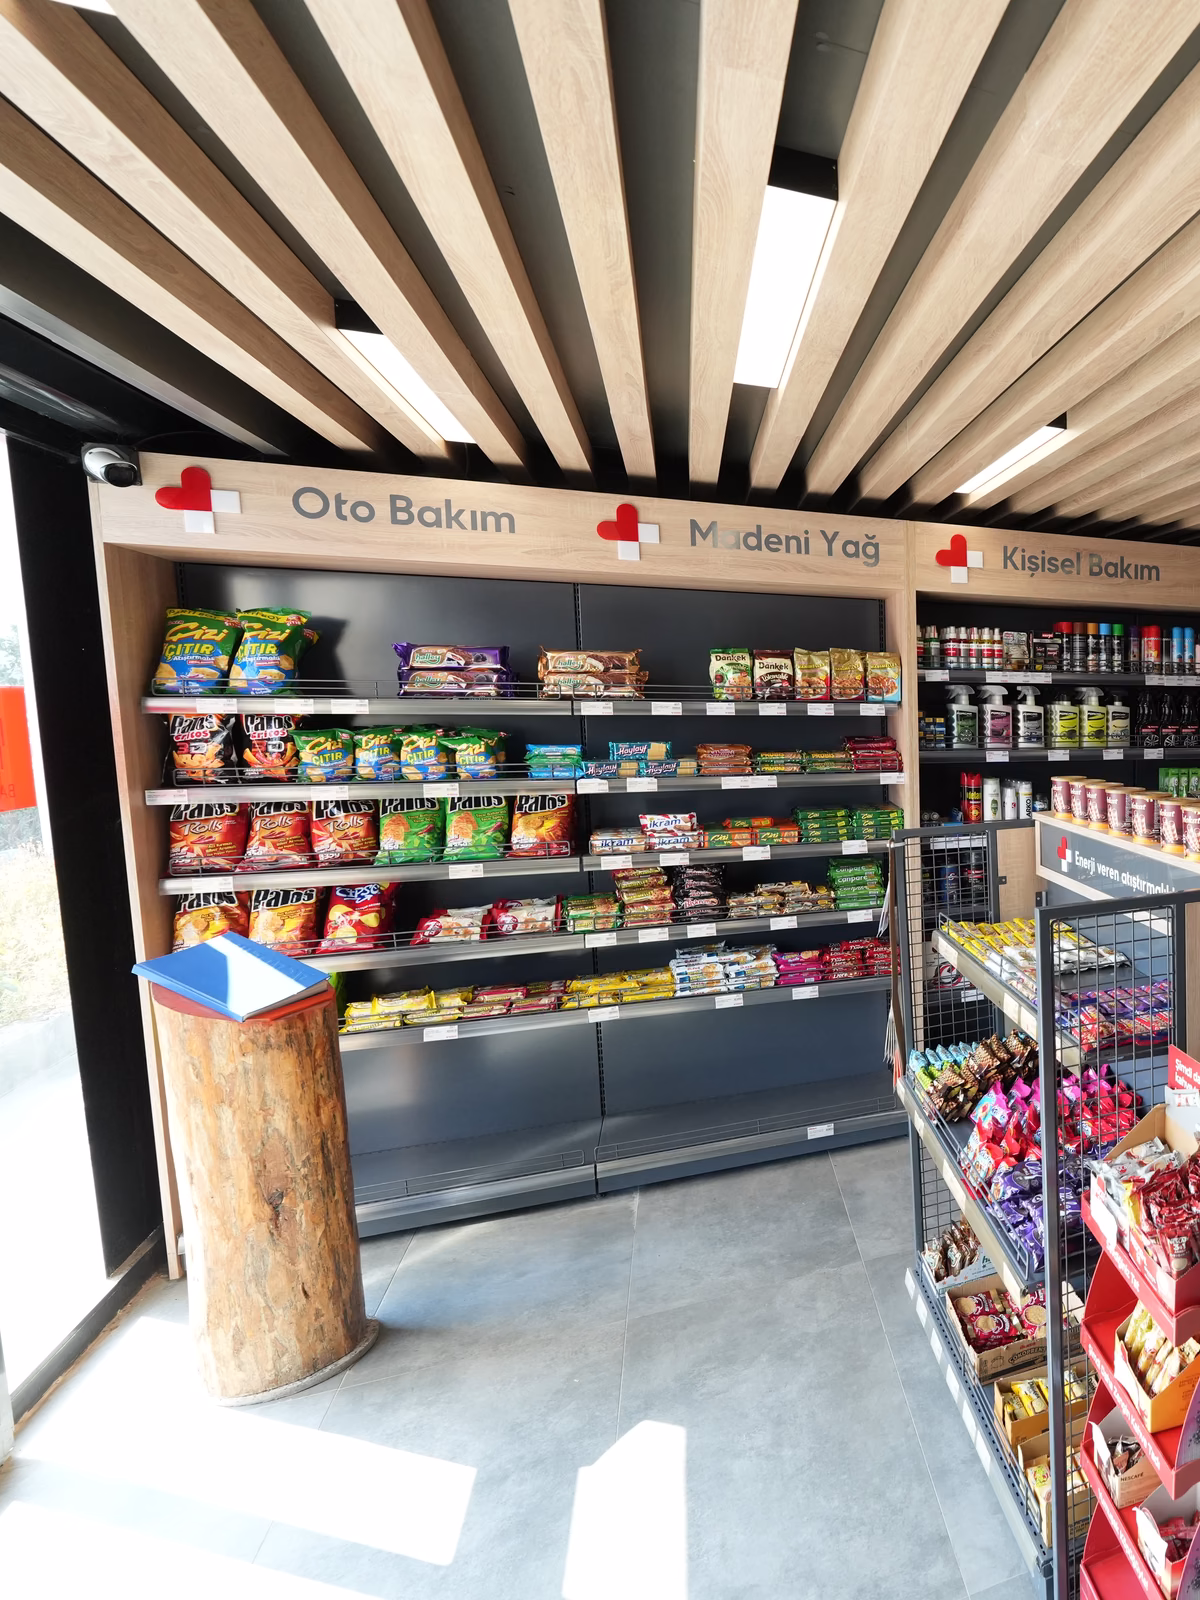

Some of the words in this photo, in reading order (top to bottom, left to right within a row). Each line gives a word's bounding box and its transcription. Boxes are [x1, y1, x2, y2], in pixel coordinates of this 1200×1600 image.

[291, 486, 375, 524] Oto
[390, 494, 516, 535] Bakım
[689, 518, 810, 556] Madeni
[819, 526, 882, 568] Yağ
[1002, 545, 1081, 578] Kişisel
[1088, 553, 1160, 582] Bakım
[714, 653, 747, 663] Dankek
[758, 662, 789, 671] Dankek
[649, 816, 682, 829] ikram
[1075, 850, 1096, 873] Enerji
[1096, 859, 1120, 882] veren
